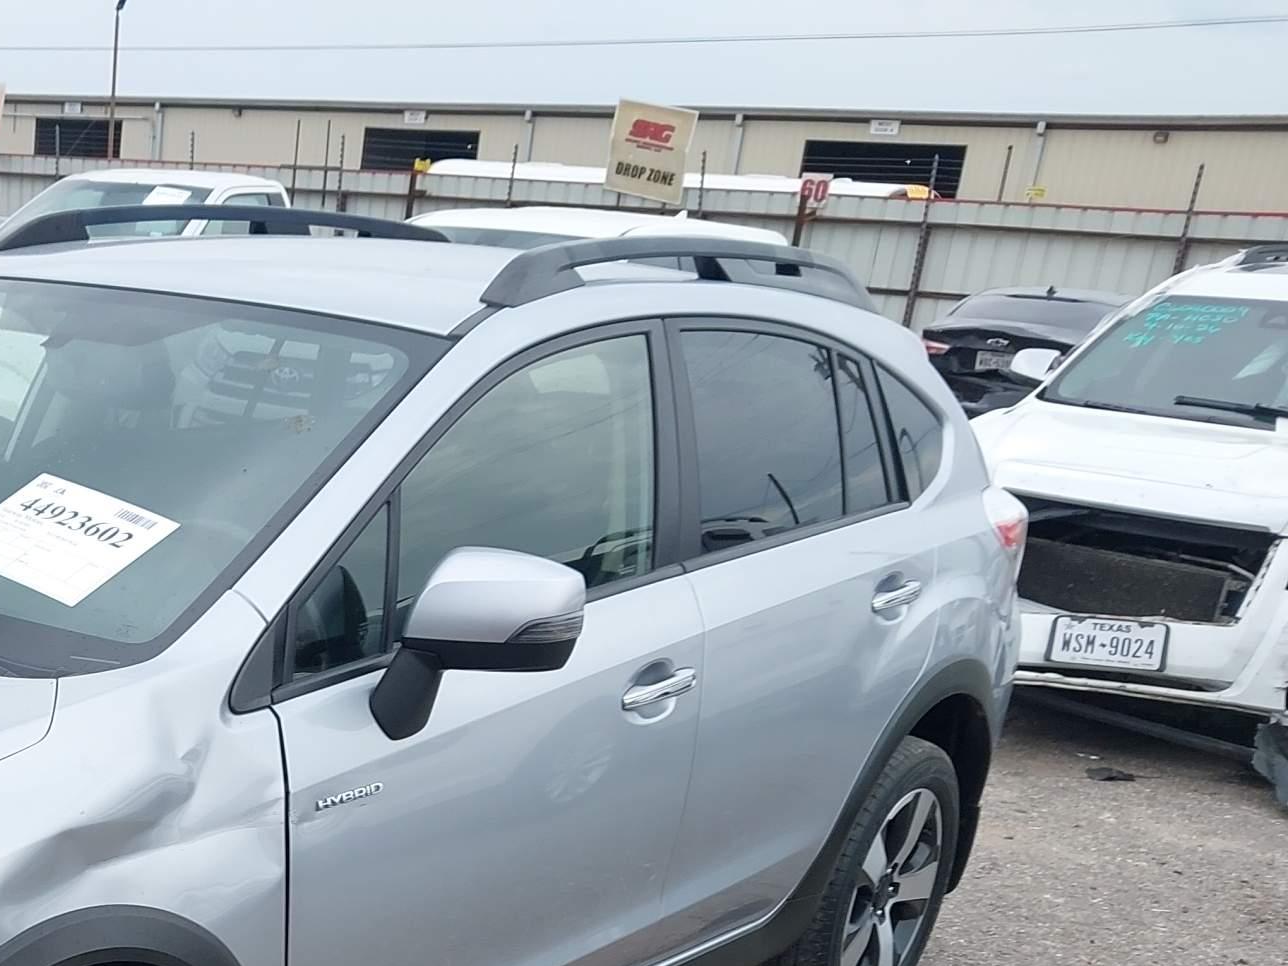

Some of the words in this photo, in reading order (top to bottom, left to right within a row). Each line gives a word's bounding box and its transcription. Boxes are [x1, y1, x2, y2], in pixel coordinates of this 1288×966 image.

[615, 161, 647, 179] DROP
[646, 168, 676, 186] ZONE
[801, 179, 829, 203] 60
[20, 498, 134, 548] 44923602
[1092, 622, 1132, 633] TEXAS
[317, 782, 384, 809] HYBRID
